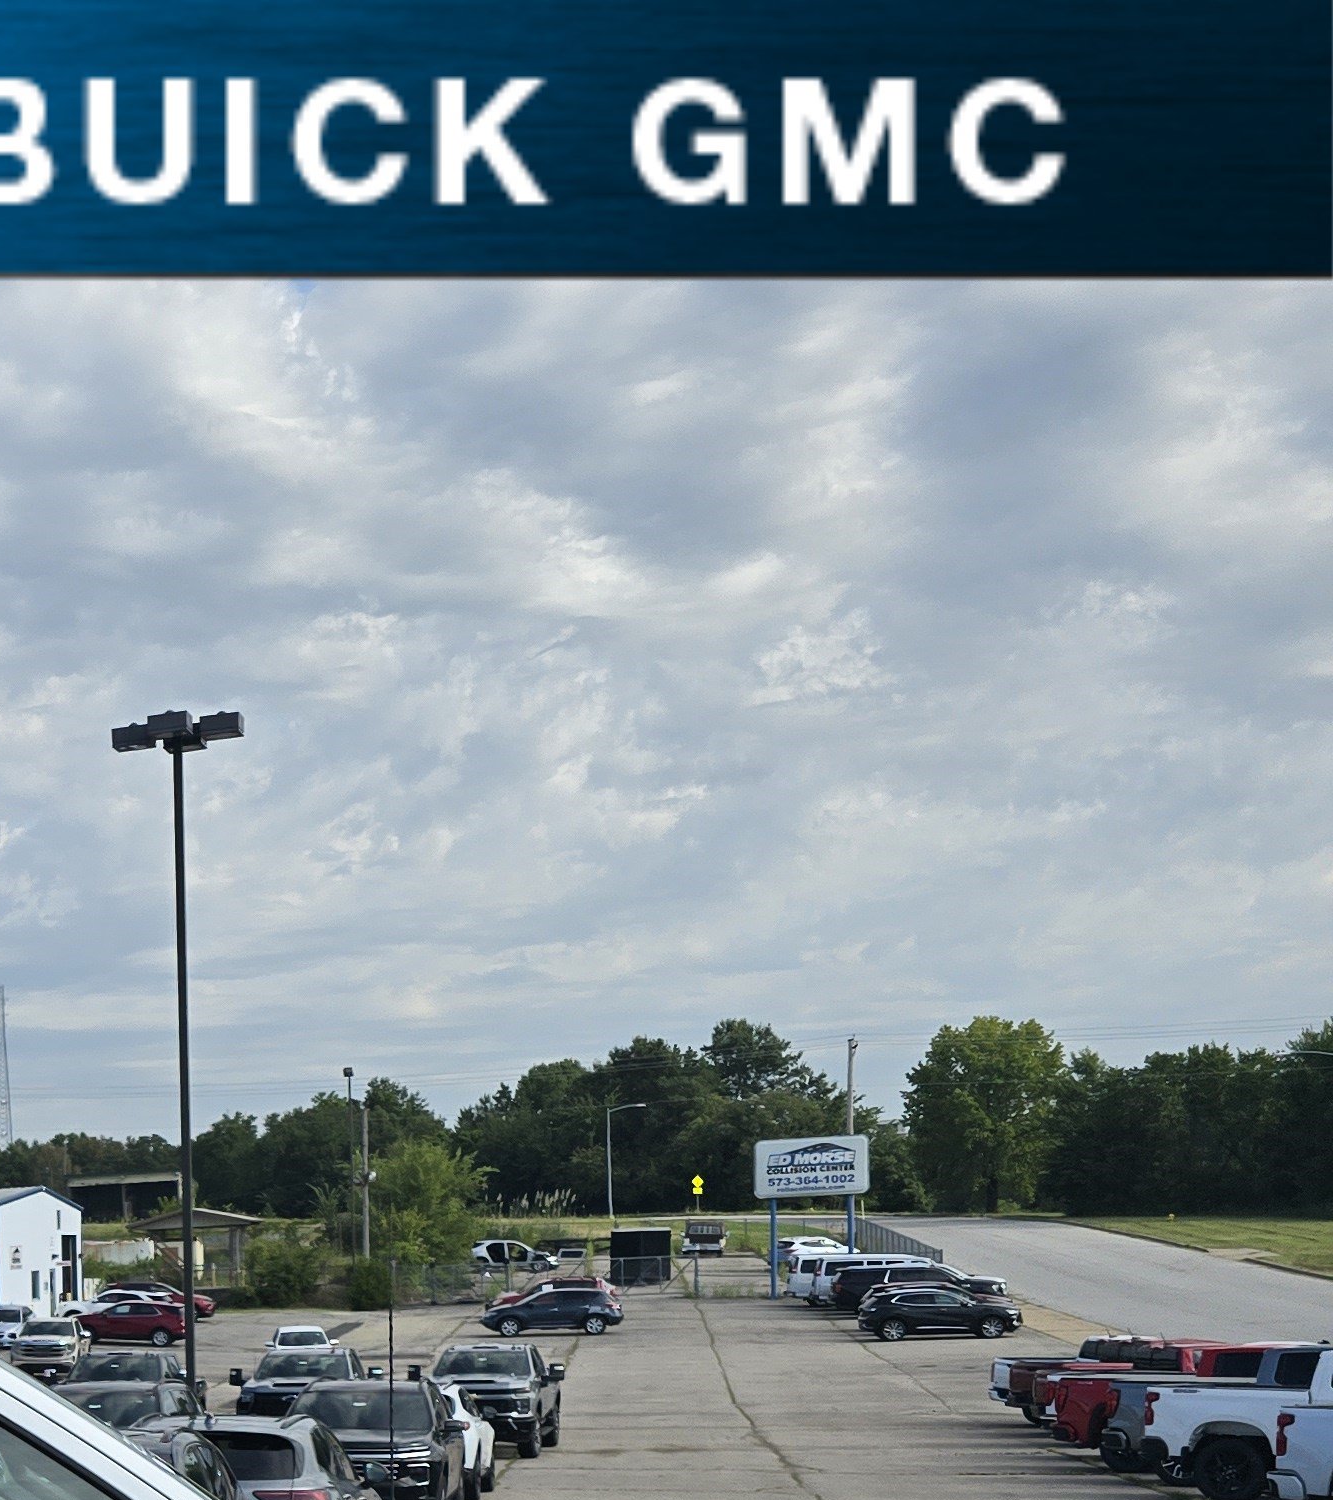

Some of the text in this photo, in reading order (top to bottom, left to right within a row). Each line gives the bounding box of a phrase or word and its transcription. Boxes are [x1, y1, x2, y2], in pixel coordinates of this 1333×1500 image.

[768, 1150, 855, 1167] ED MORSE
[766, 1163, 856, 1175] COLLISION CENTER
[767, 1174, 855, 1187] 573-364-1002
